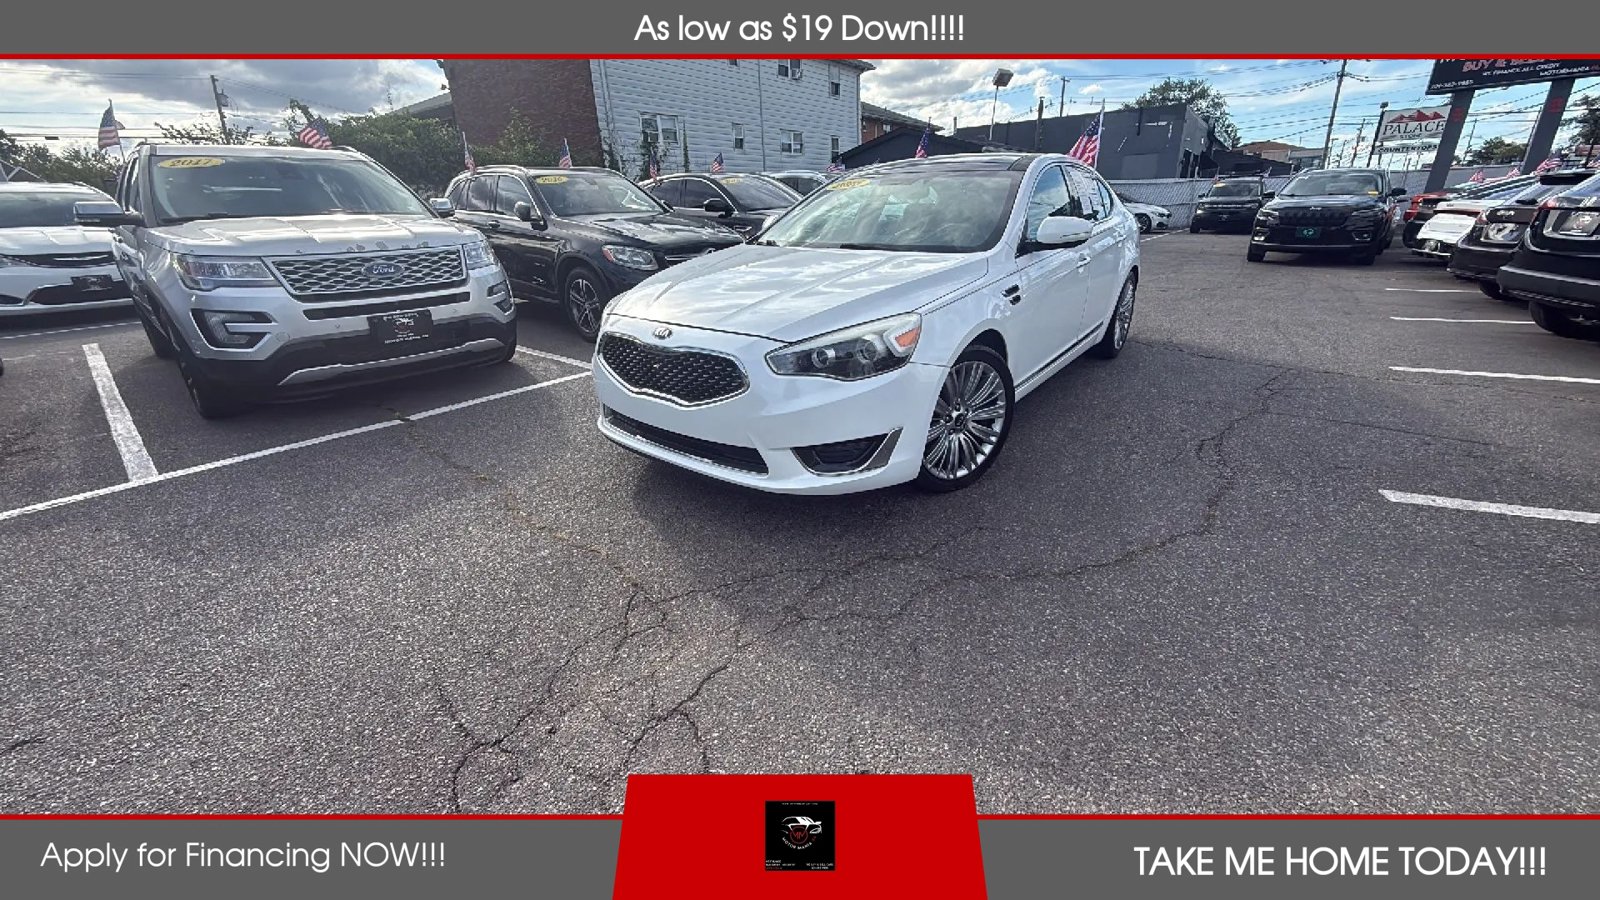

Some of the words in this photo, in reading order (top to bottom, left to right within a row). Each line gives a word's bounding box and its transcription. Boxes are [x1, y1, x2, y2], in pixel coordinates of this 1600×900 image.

[1462, 58, 1493, 73] BUY
[1536, 62, 1561, 71] CREDIT
[1382, 119, 1447, 136] PALACE
[1377, 144, 1438, 154] COUNTERTOPS
[169, 158, 212, 167] 2017
[372, 264, 396, 274] Ford
